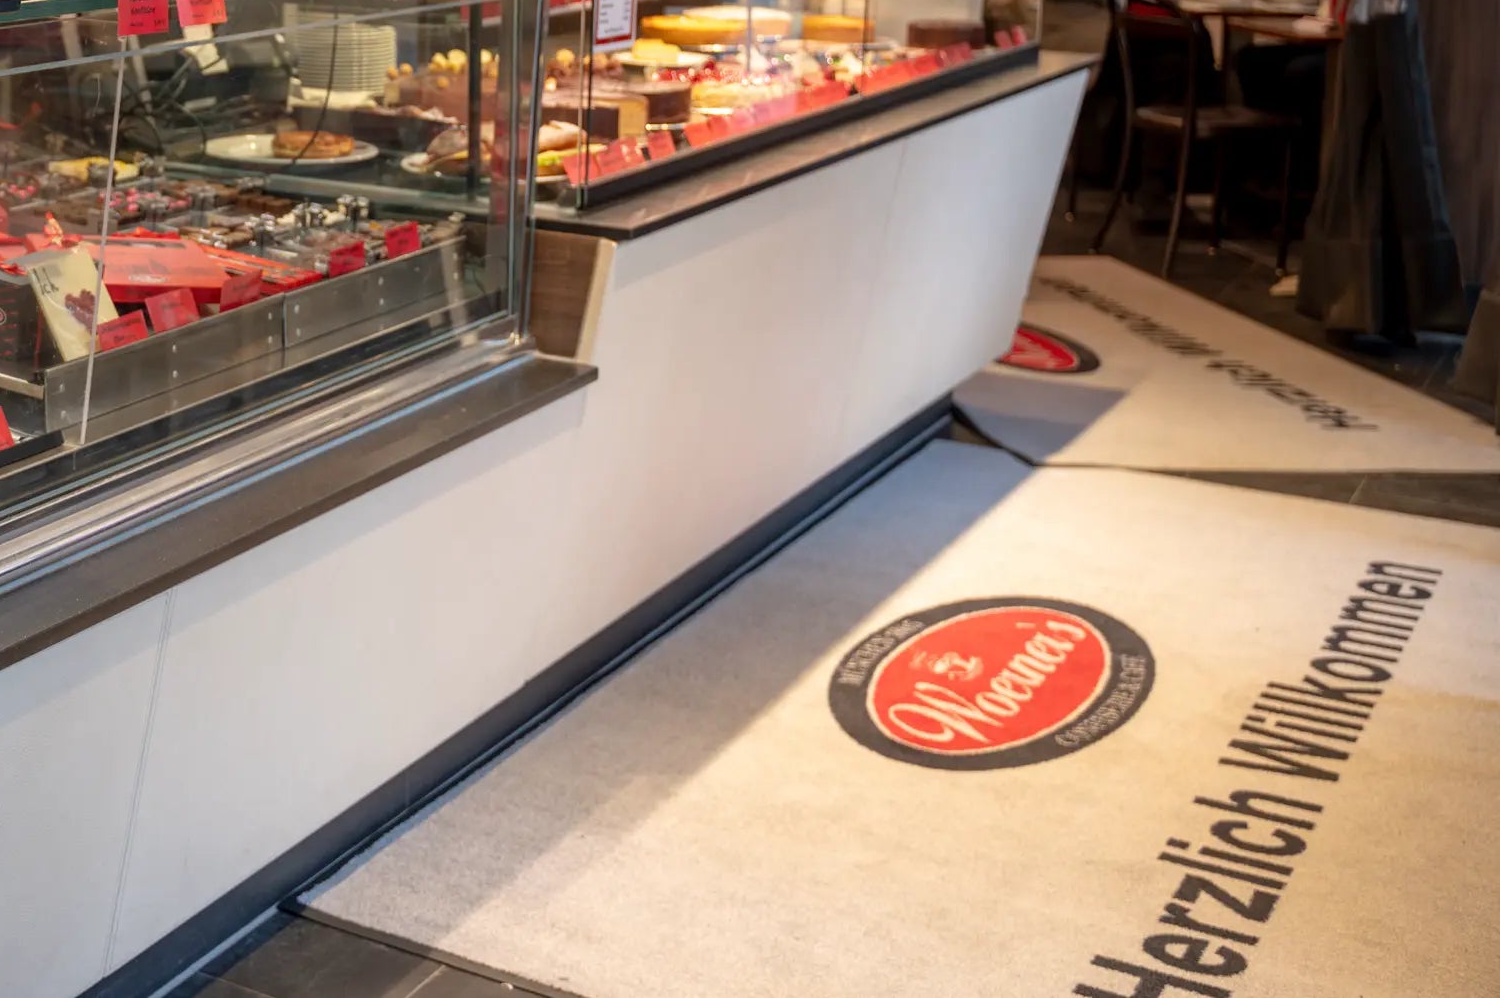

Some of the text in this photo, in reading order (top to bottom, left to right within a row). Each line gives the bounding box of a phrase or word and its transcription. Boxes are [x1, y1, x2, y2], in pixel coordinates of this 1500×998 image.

[887, 619, 1087, 745] Woerner's
[1071, 559, 1444, 998] Herzlich Willkommen
